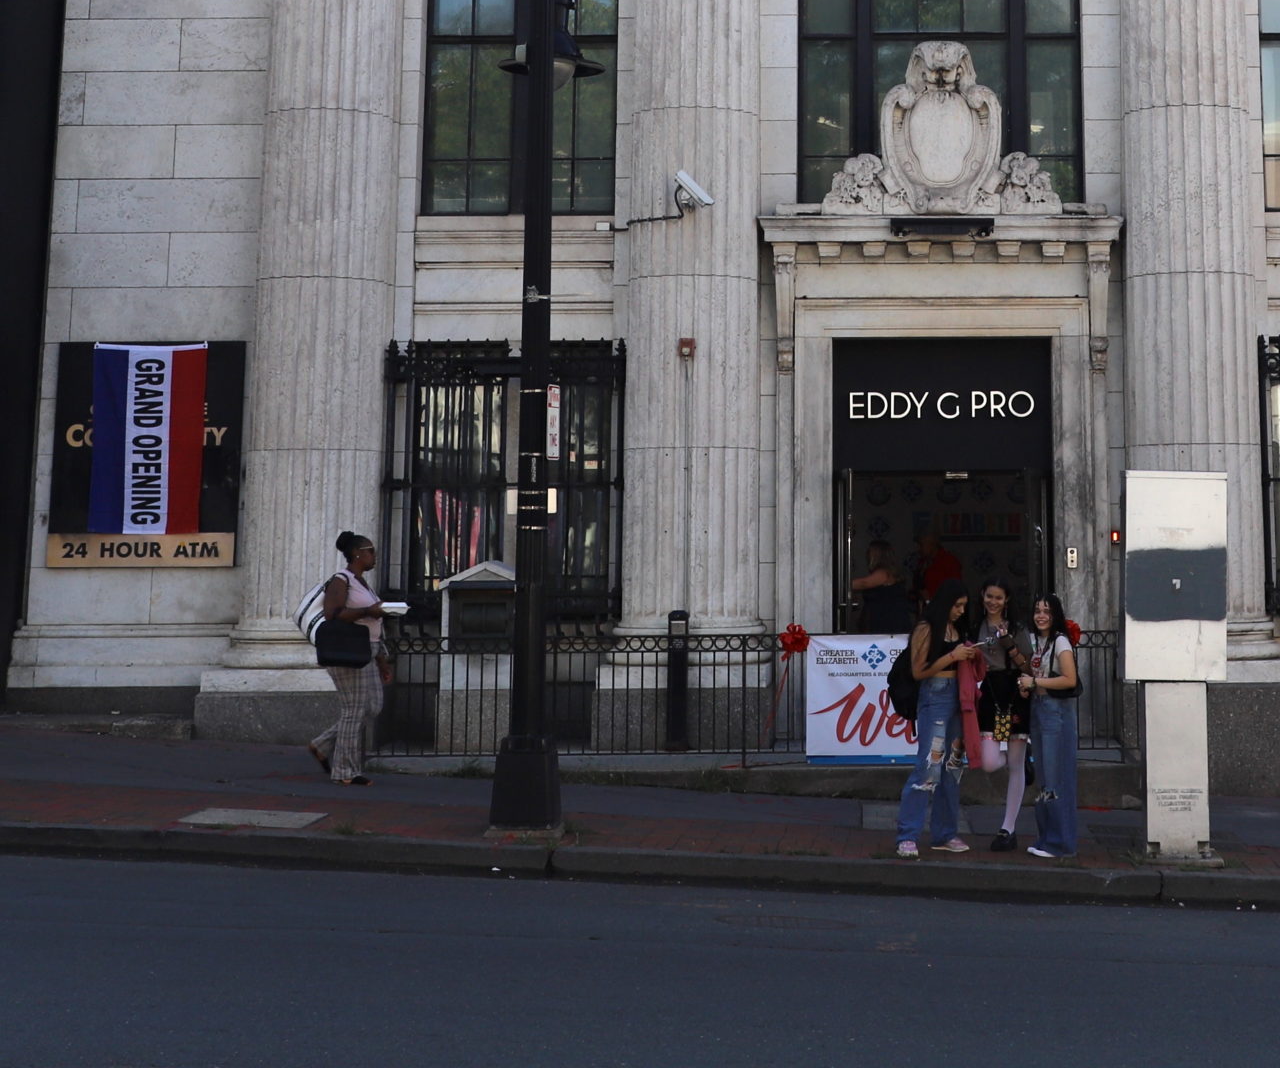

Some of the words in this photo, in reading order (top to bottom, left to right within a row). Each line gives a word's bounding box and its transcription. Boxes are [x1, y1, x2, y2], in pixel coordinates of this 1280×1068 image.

[134, 358, 165, 429] GRAND
[849, 392, 929, 419] EDDY
[936, 392, 960, 419] G
[971, 391, 1035, 418] PRO
[130, 434, 163, 525] OPENING
[62, 542, 88, 558] 24
[100, 542, 162, 558] HOUR
[173, 541, 219, 558] ATM
[816, 657, 859, 665] ELIZABETH
[818, 649, 855, 657] GREATER
